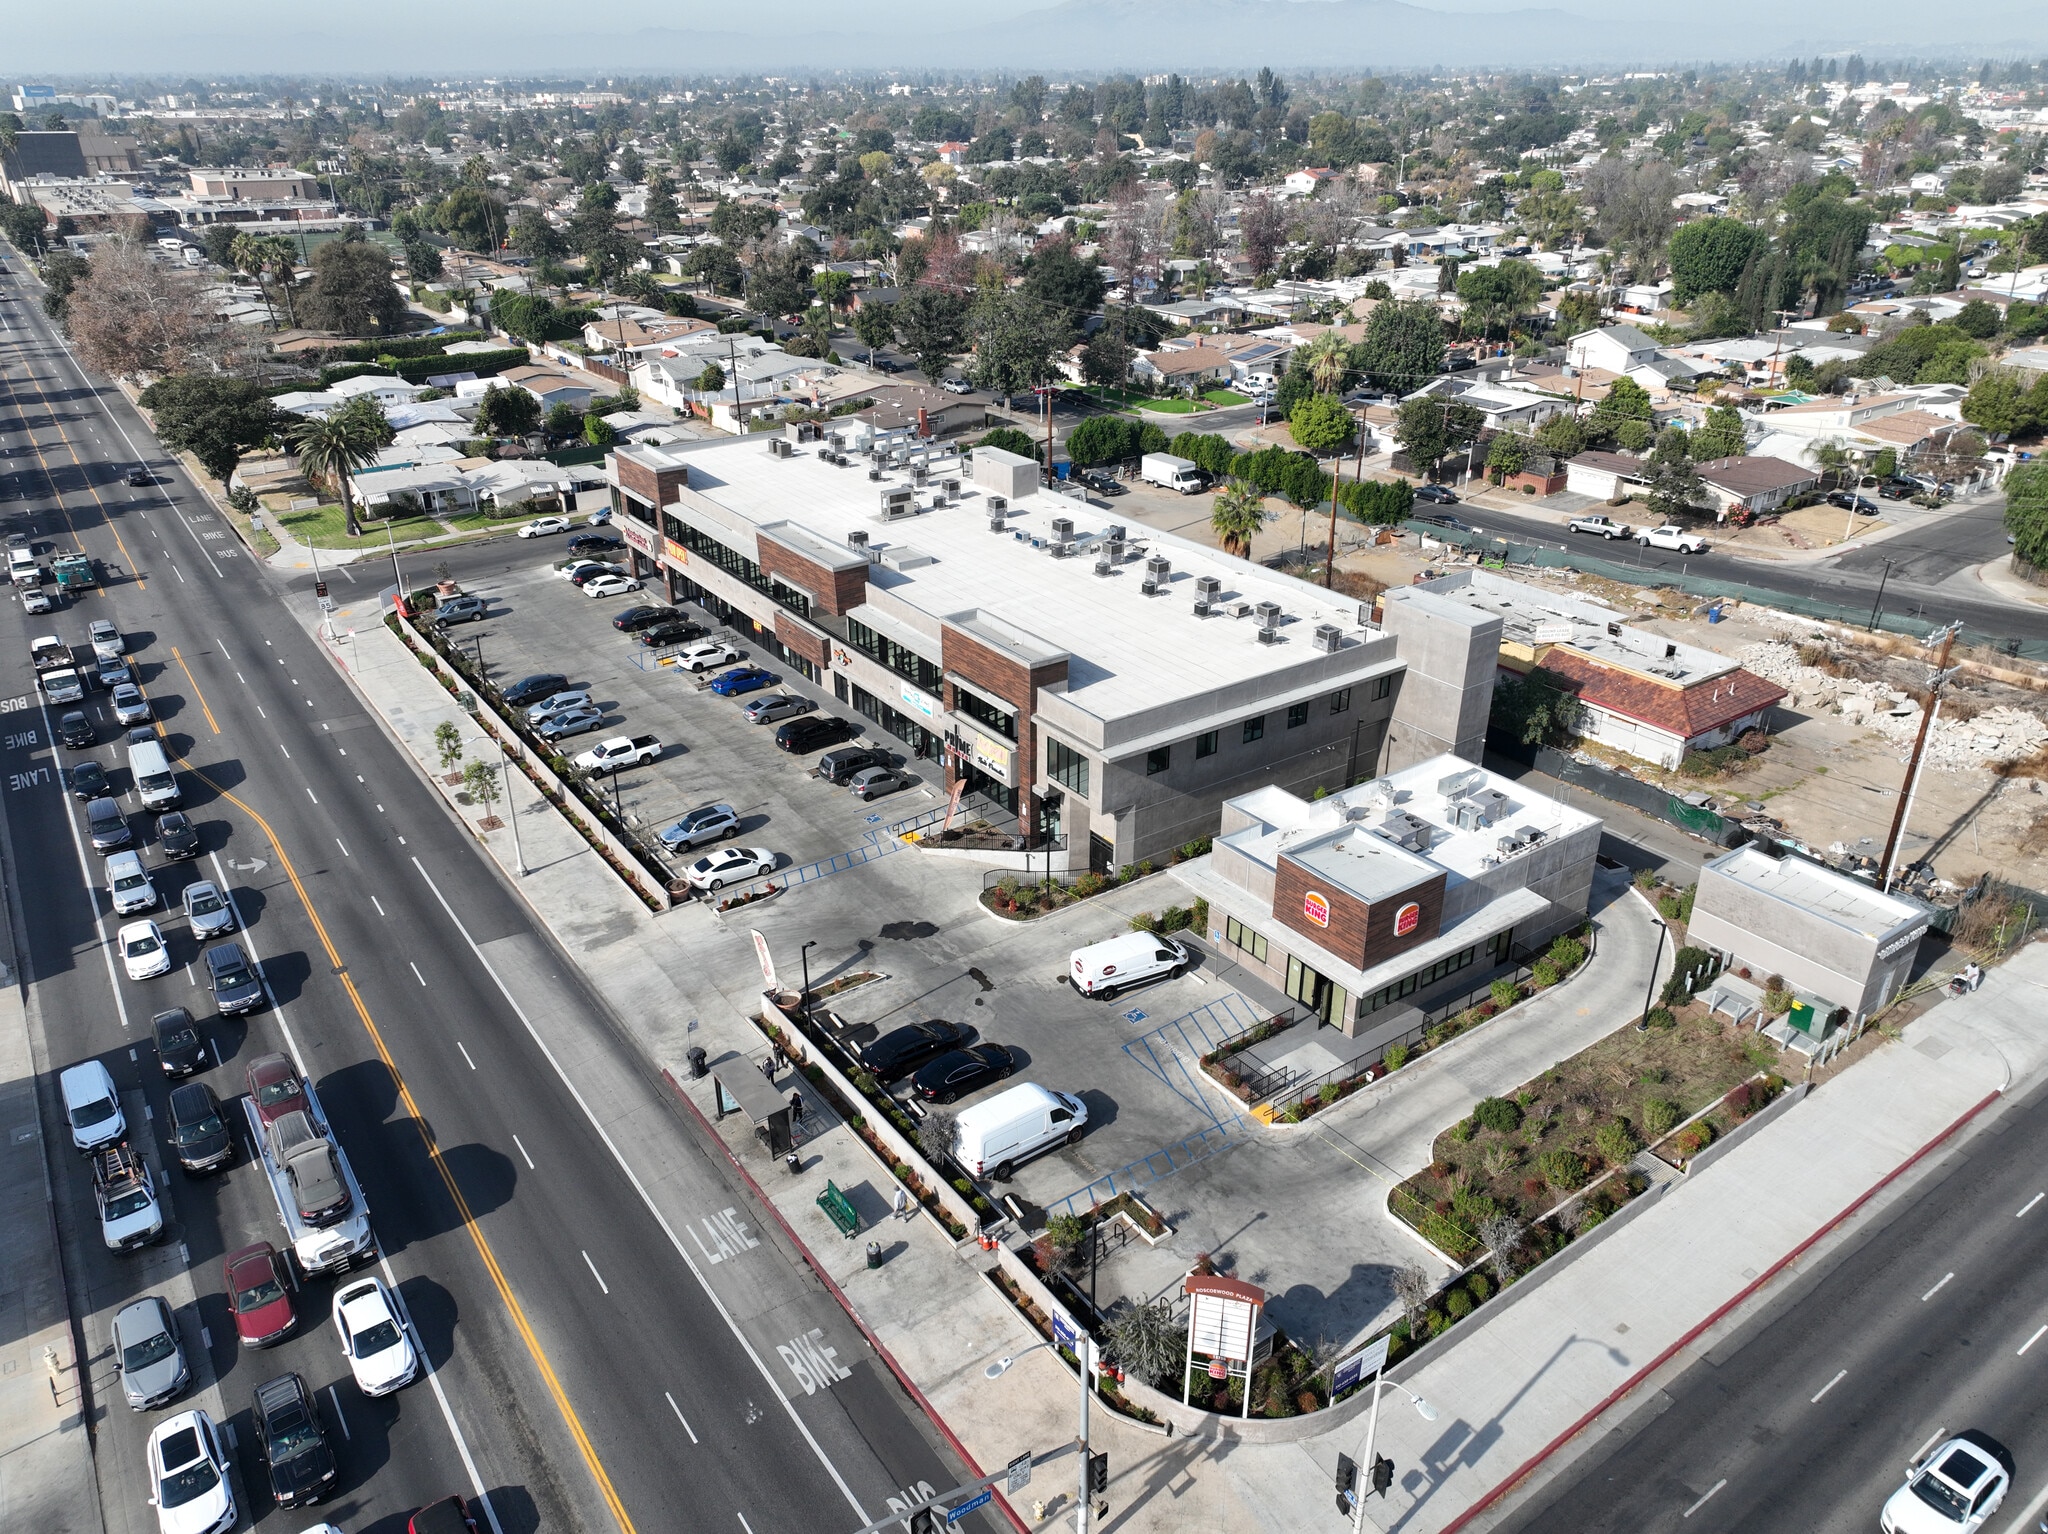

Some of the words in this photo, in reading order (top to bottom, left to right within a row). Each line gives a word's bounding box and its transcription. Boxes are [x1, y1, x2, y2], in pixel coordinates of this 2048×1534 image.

[188, 514, 214, 523] LANE
[202, 531, 226, 541] BIKE
[216, 549, 238, 559] BUS
[0, 696, 28, 713] BUS
[4, 730, 38, 750] BIKE
[944, 725, 971, 757] PRIME
[9, 767, 50, 791] LANE
[1305, 898, 1328, 915] BURGER
[1305, 905, 1327, 923] KING
[1397, 916, 1418, 932] KING
[1398, 910, 1419, 922] BURGER
[686, 1207, 760, 1265] LANE
[1195, 1288, 1234, 1297] ROSCOEWOOD
[1235, 1293, 1254, 1303] PLAZA
[776, 1328, 852, 1396] BIKE
[949, 1494, 990, 1520] Woodman
